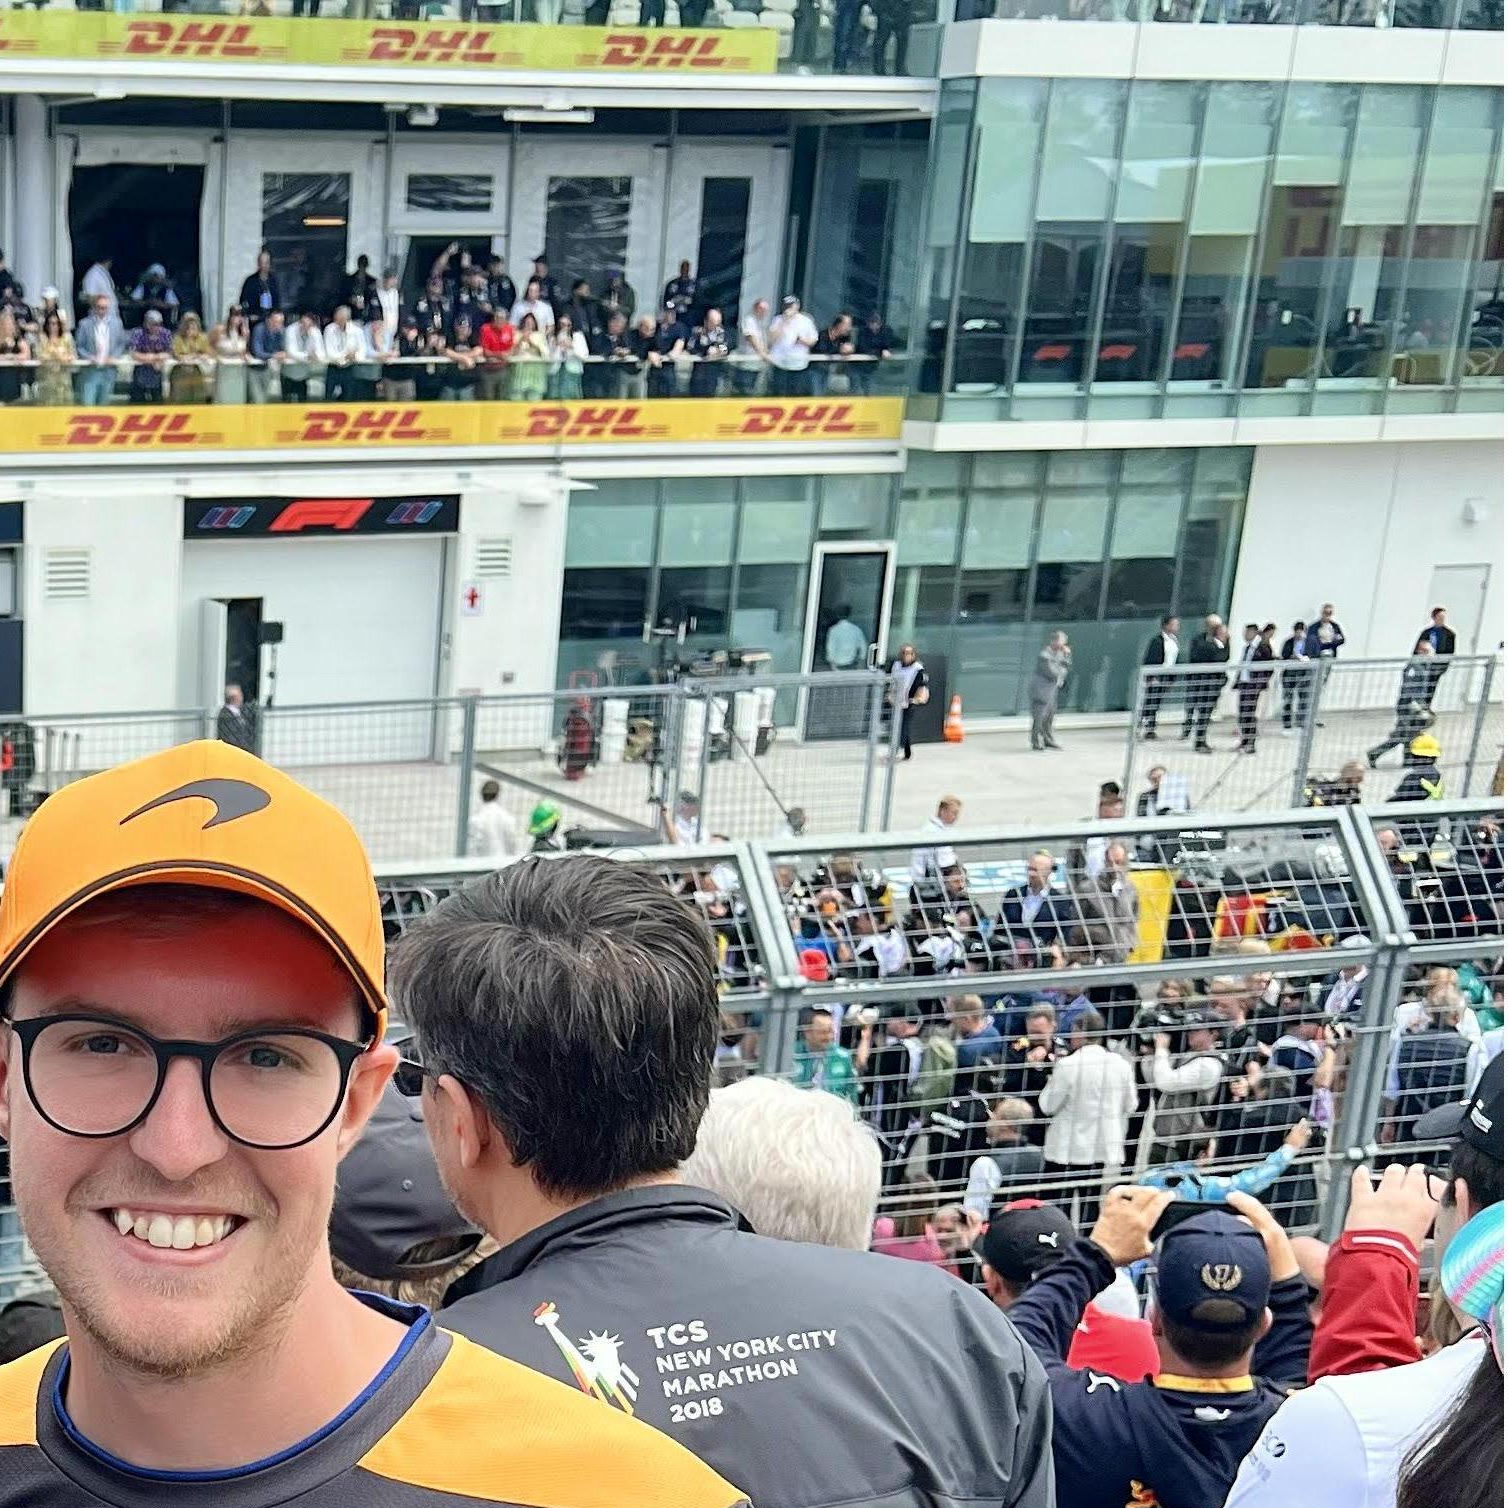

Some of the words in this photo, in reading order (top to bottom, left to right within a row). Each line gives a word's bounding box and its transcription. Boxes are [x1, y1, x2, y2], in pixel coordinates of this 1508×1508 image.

[124, 21, 261, 57] DHL
[368, 28, 498, 63] DHL
[601, 35, 731, 67] DHL
[66, 413, 199, 445] DHL
[301, 410, 427, 441] DHL
[526, 407, 646, 438] DHL
[739, 405, 856, 435] DHL
[646, 1320, 709, 1350] TCS
[655, 1347, 712, 1374] NEW
[717, 1335, 785, 1362] YORK
[786, 1329, 837, 1351] CITY
[662, 1358, 799, 1398] MARATHON
[669, 1396, 724, 1423] 2018
